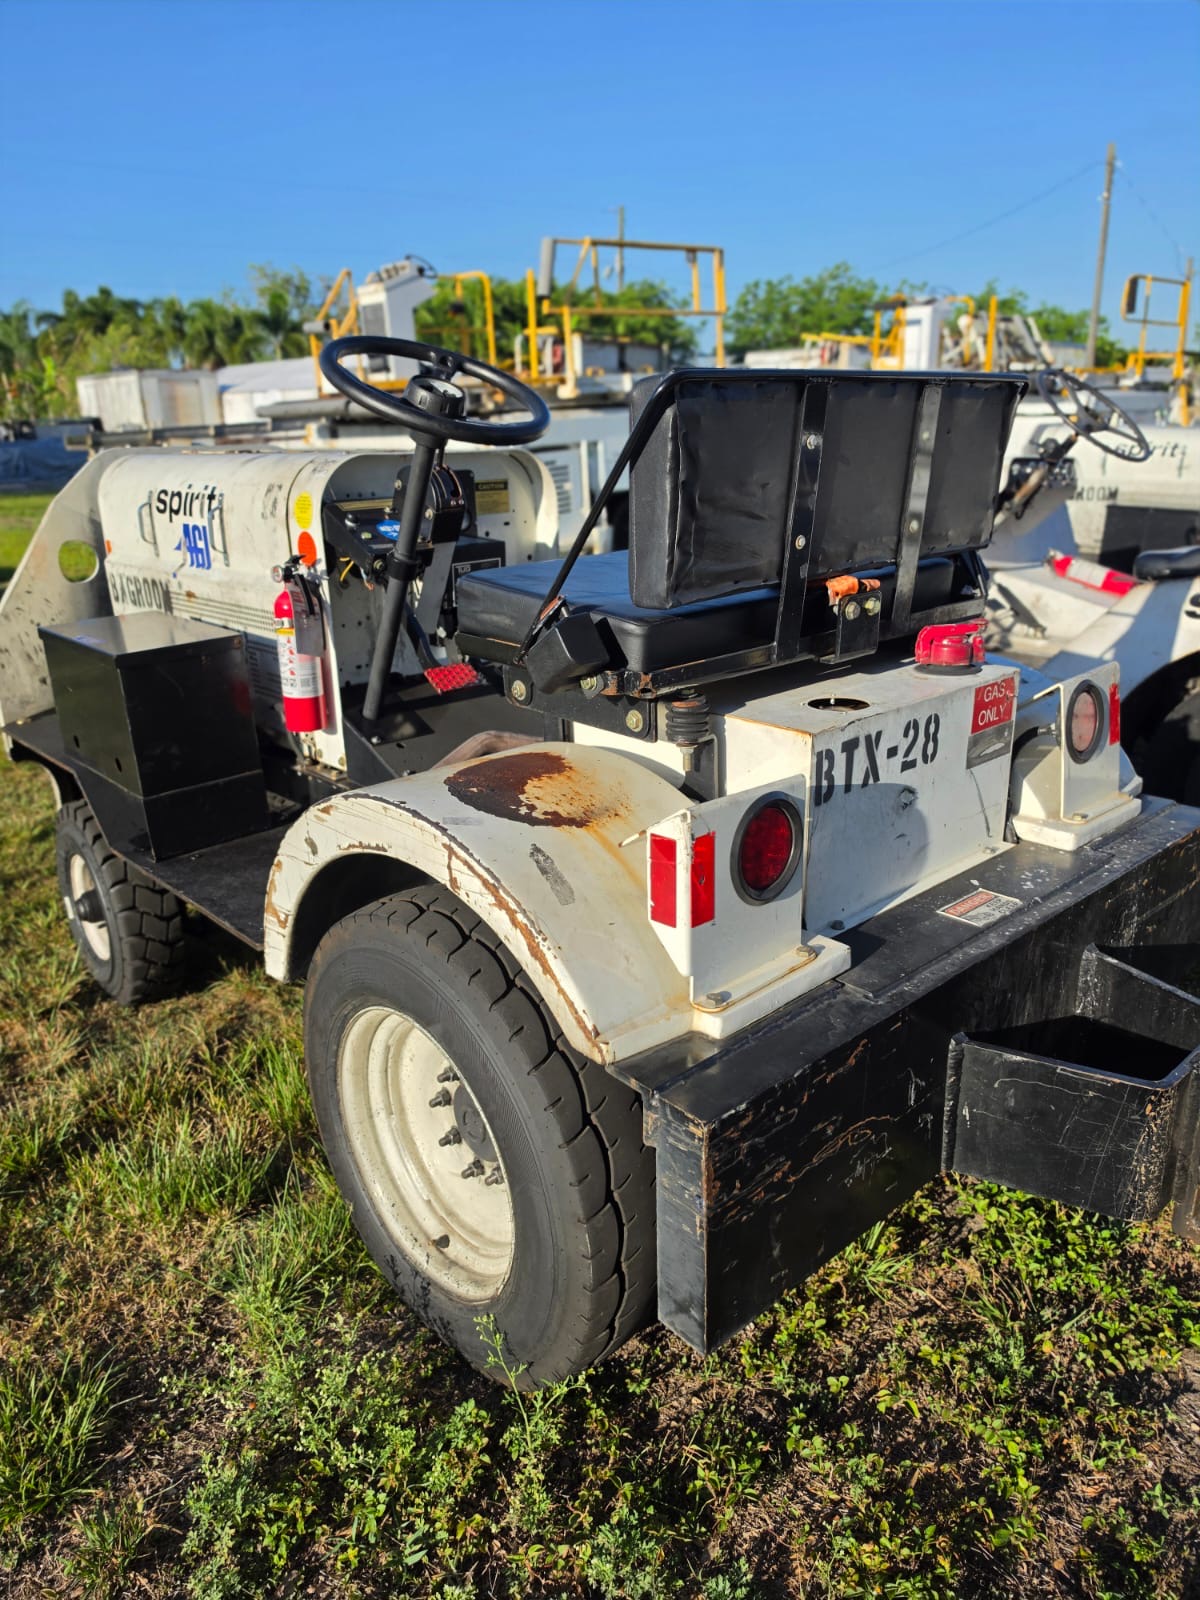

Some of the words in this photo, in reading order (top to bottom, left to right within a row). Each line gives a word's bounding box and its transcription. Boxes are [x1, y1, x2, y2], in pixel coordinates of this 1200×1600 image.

[156, 484, 216, 523] spirit
[983, 682, 1006, 703] GAS
[978, 703, 1007, 726] ONLY
[814, 713, 941, 807] BTX-28
